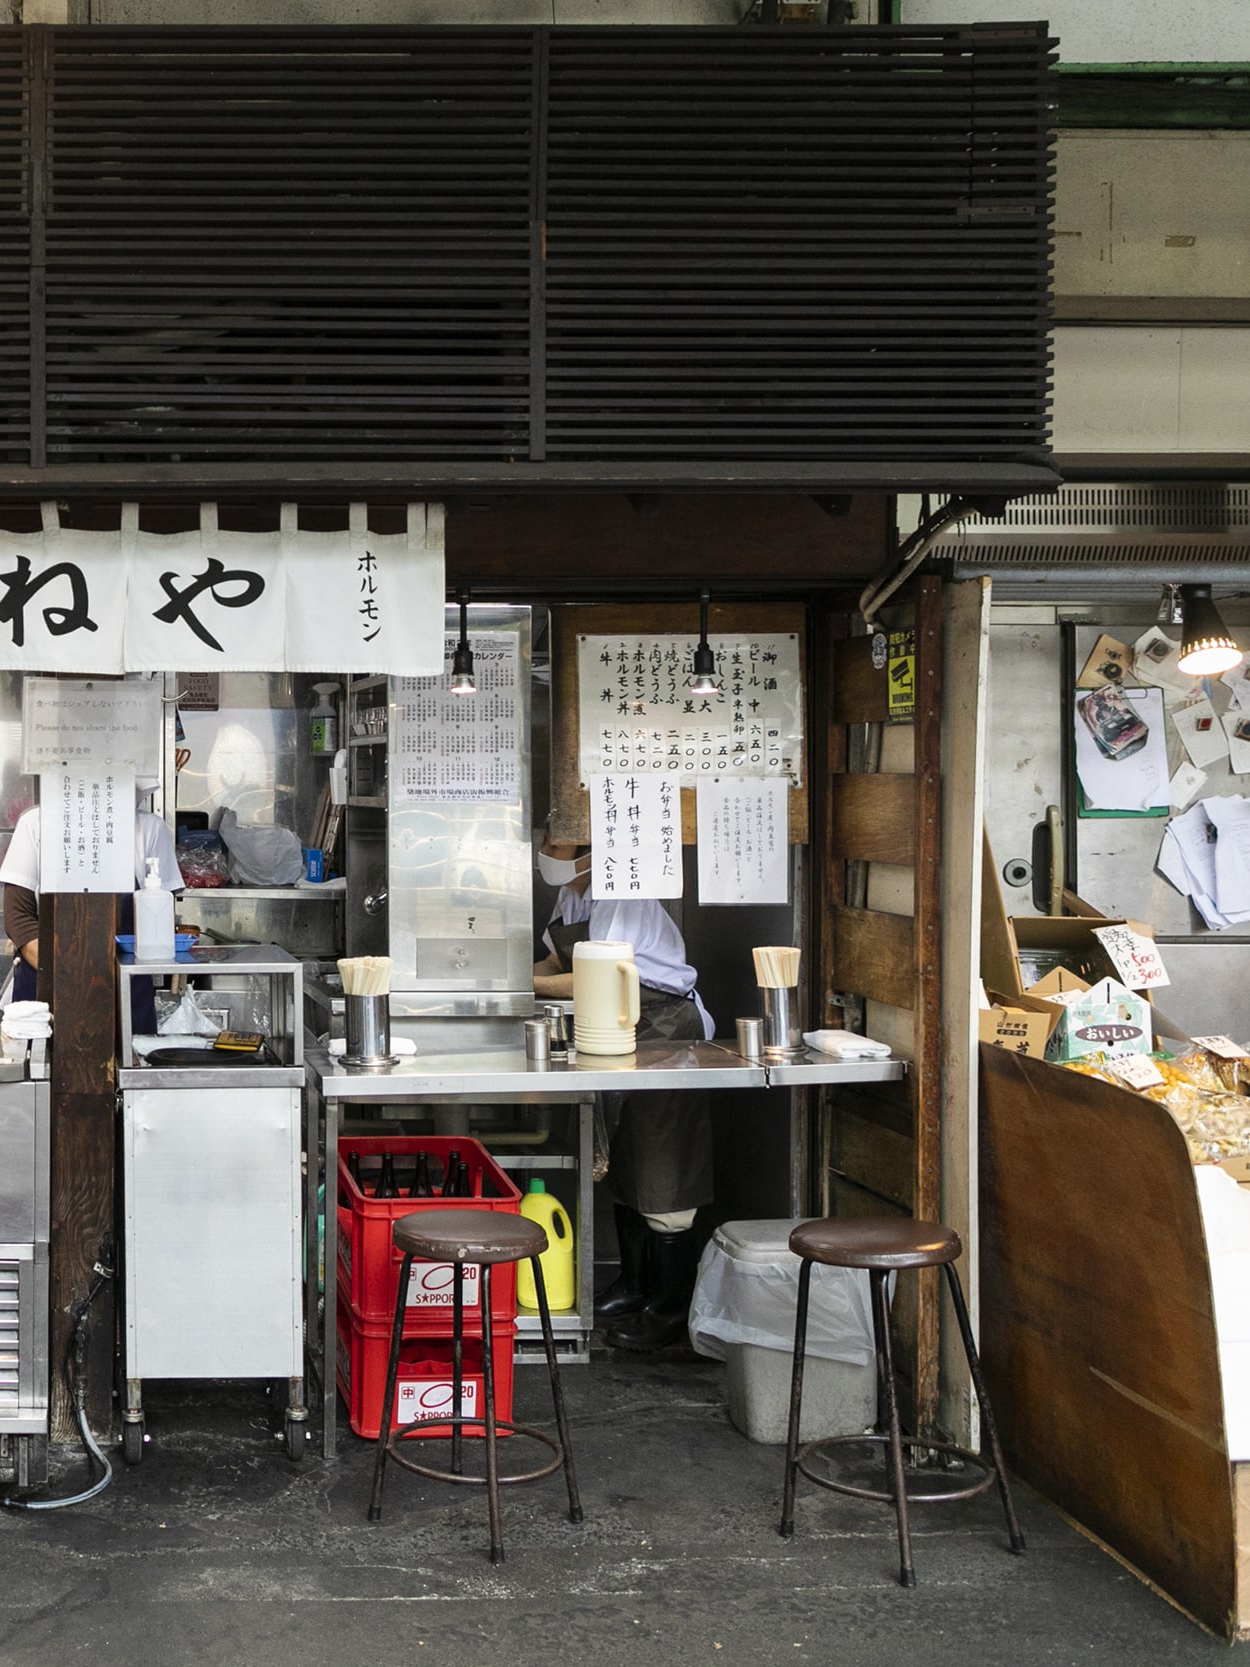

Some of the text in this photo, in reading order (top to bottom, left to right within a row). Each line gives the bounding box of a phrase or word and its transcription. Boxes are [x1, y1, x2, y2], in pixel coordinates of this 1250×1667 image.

[357, 550, 382, 643] ホルモン
[616, 649, 631, 717] ホルモン丼
[632, 649, 647, 717] ホルモン煮
[648, 649, 664, 705] 肉どうふ
[664, 649, 680, 705] 焼どうふ
[682, 649, 695, 688] ごはん
[714, 650, 729, 704] おしんこ
[731, 651, 745, 696] 生玉子
[748, 650, 762, 688] ビール
[699, 700, 712, 713] 大
[748, 698, 760, 714] 中
[36, 723, 138, 732] Please do not share the food
[1131, 952, 1155, 967] 500
[1138, 968, 1162, 985] 300
[1085, 1027, 1135, 1040] おいしい
